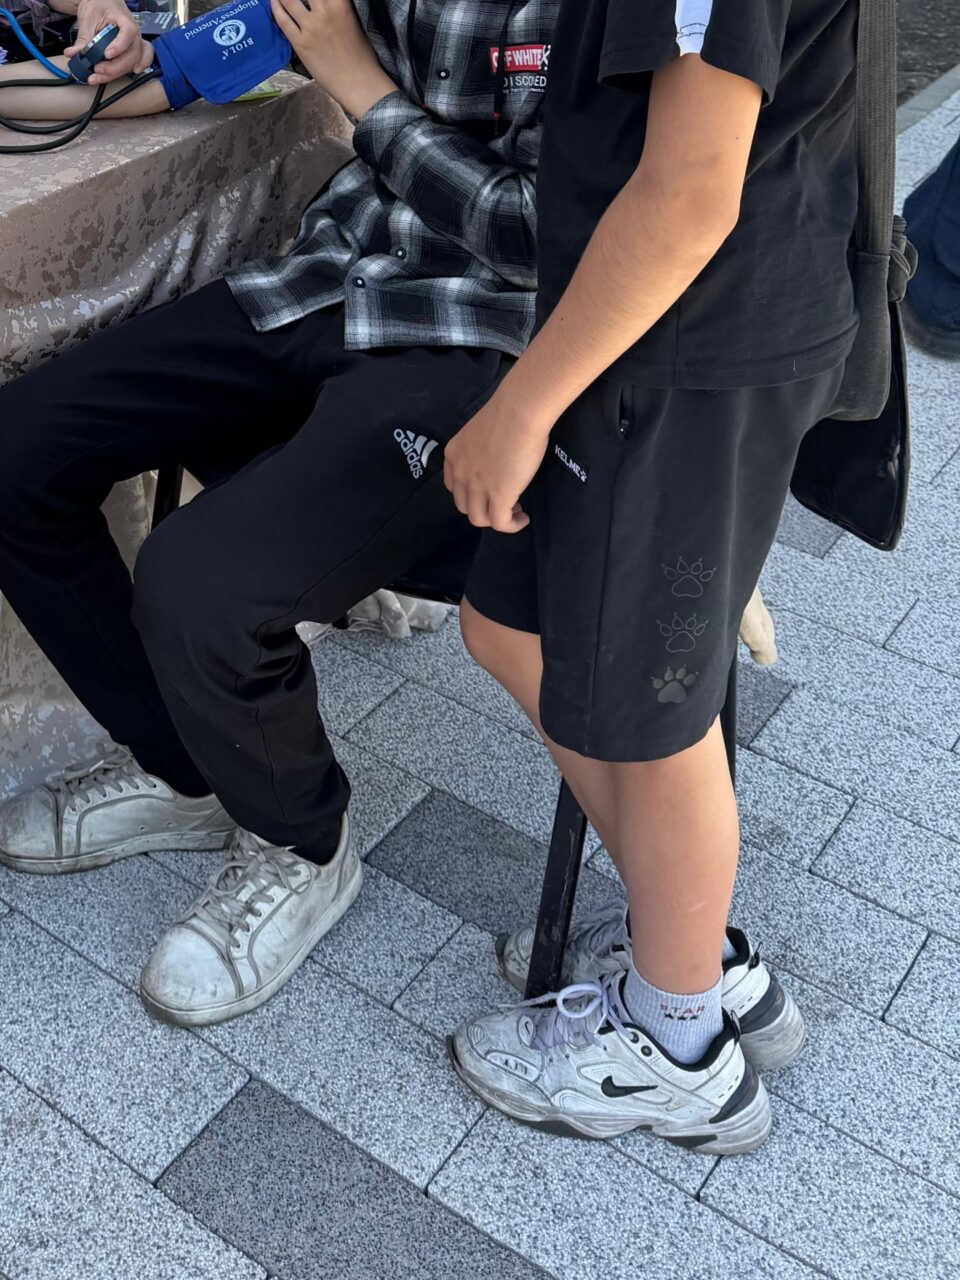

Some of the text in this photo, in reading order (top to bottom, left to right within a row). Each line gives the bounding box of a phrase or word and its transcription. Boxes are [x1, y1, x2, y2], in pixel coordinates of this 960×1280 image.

[184, 17, 220, 40] Aneroid
[393, 428, 423, 480] adidas
[554, 443, 582, 478] KELME
[660, 1003, 705, 1015] STAR
